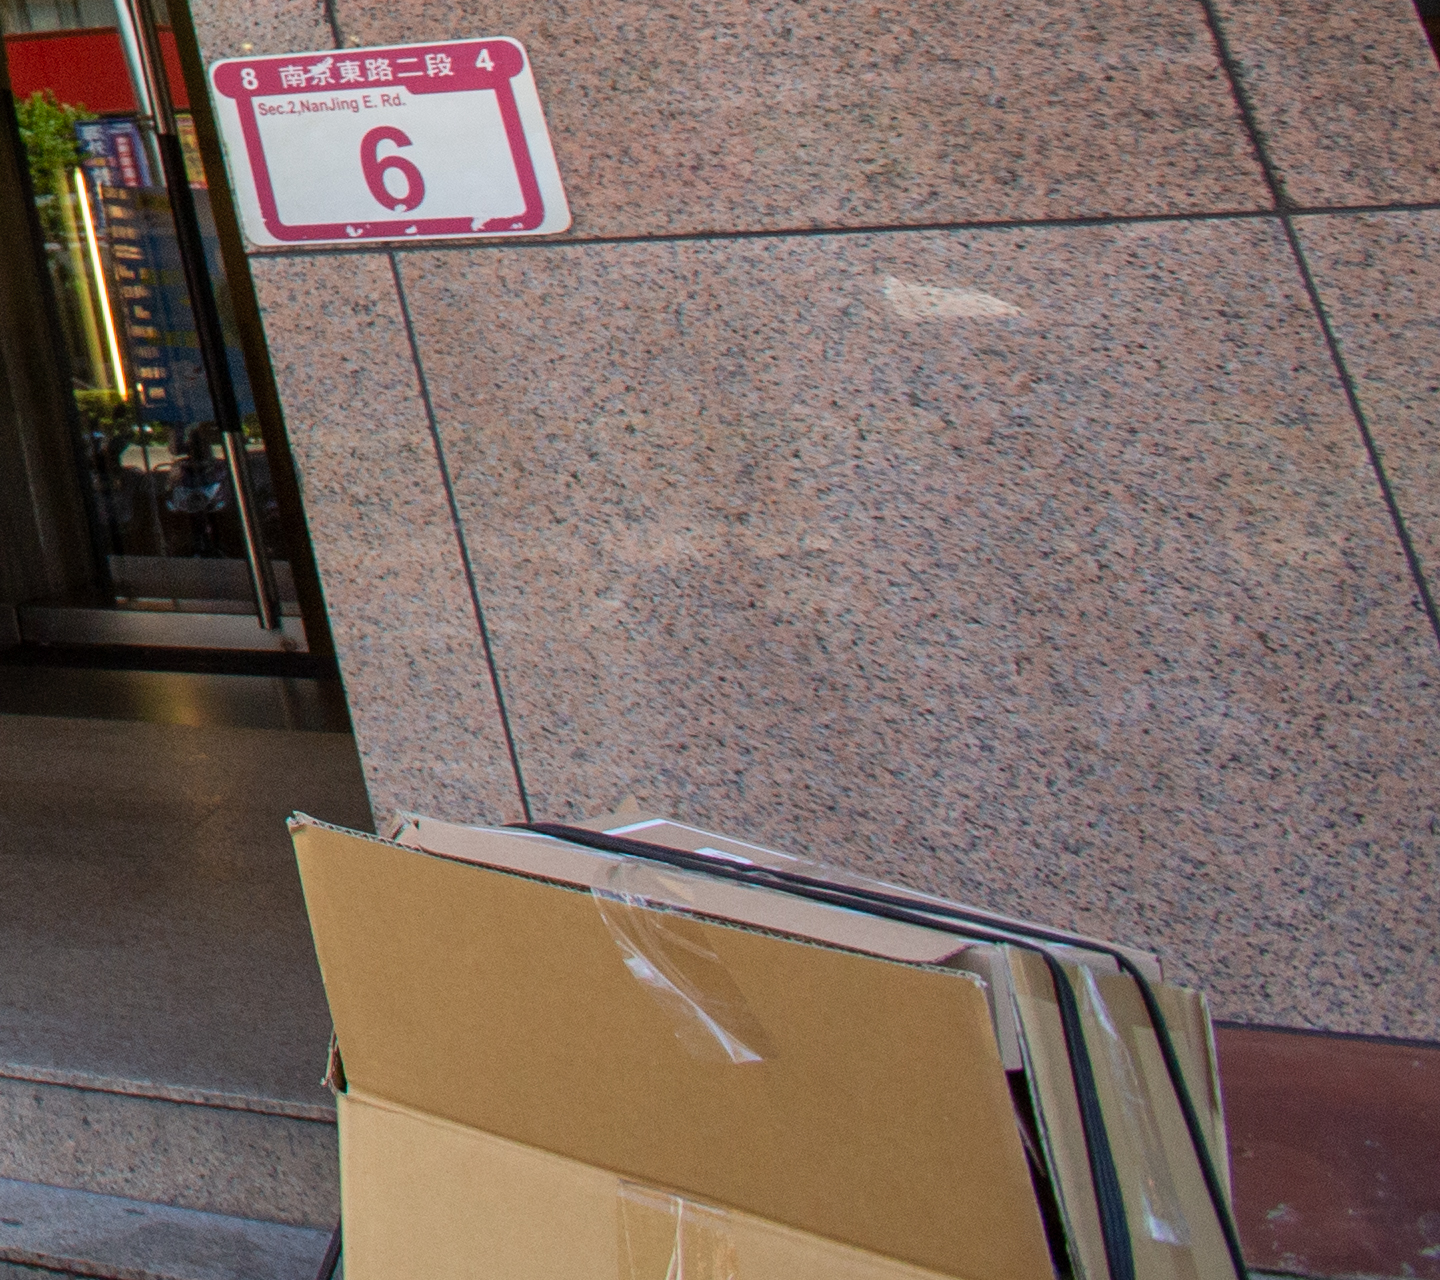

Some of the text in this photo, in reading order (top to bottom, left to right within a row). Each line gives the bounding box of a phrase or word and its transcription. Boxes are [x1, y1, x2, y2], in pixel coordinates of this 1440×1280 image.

[241, 49, 494, 90] 8 南京東路二段 4
[363, 95, 379, 110] E.
[381, 93, 406, 108] Rd.
[360, 126, 426, 213] 6
